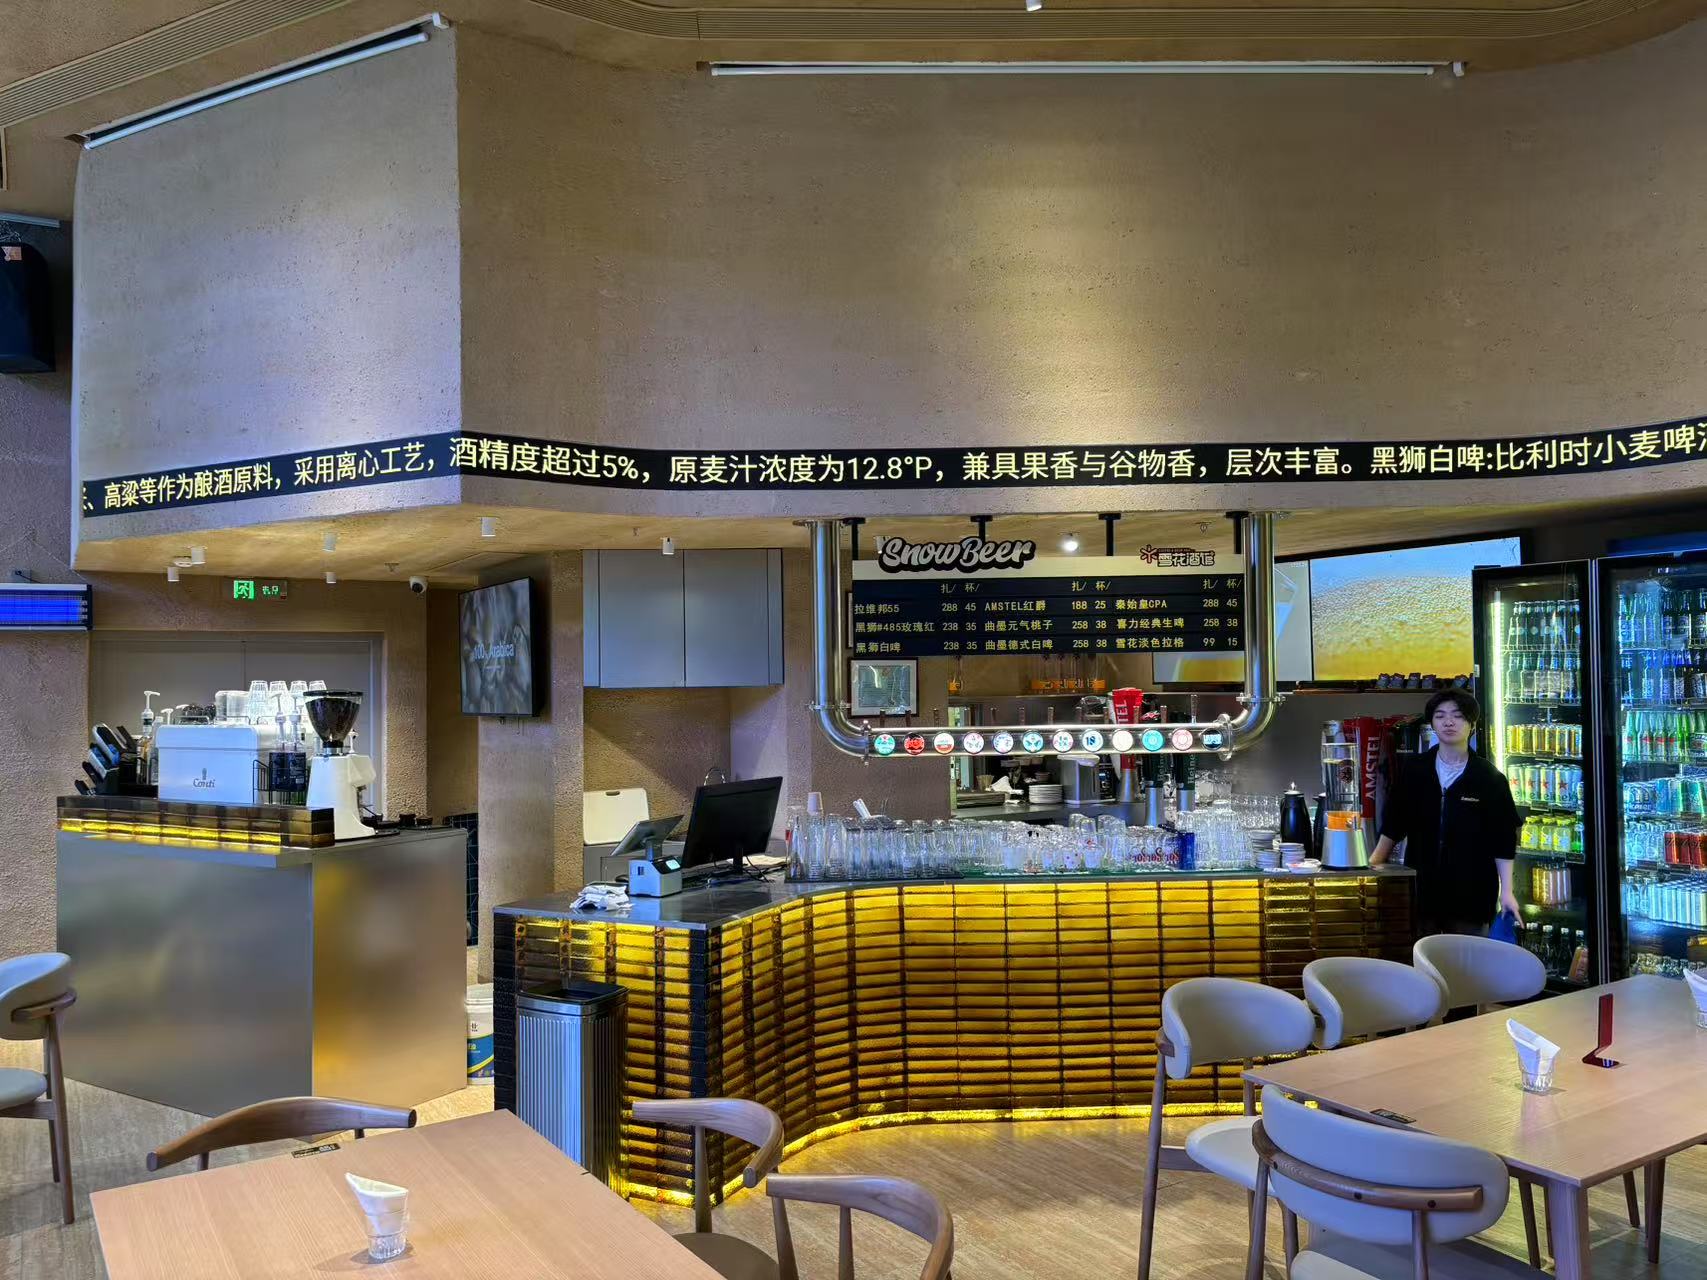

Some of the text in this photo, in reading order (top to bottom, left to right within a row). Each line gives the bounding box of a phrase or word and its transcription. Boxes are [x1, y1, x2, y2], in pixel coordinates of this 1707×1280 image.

[293, 441, 436, 486] 采用离心工艺，
[449, 437, 651, 484] 酒精度超过5%，
[961, 450, 1208, 482] 兼具果香与谷物香，
[1225, 446, 1353, 476] 层次丰富。
[941, 602, 959, 613] 288
[964, 602, 977, 612] 45
[984, 600, 1107, 612] AMSTEL红爵 188 25
[1202, 598, 1220, 608] 288
[1226, 598, 1239, 608] 45
[942, 622, 959, 631] 238
[965, 622, 978, 631] 35
[1071, 620, 1089, 630] 258
[1095, 620, 1108, 630] 38
[1116, 617, 1239, 630] 喜力经典生啤 258 38
[856, 641, 978, 654] 黑狮白啤 238 35
[1072, 639, 1089, 649] 258
[1095, 639, 1108, 649] 38
[1115, 637, 1239, 649] 雪花淡色拉格 99 15
